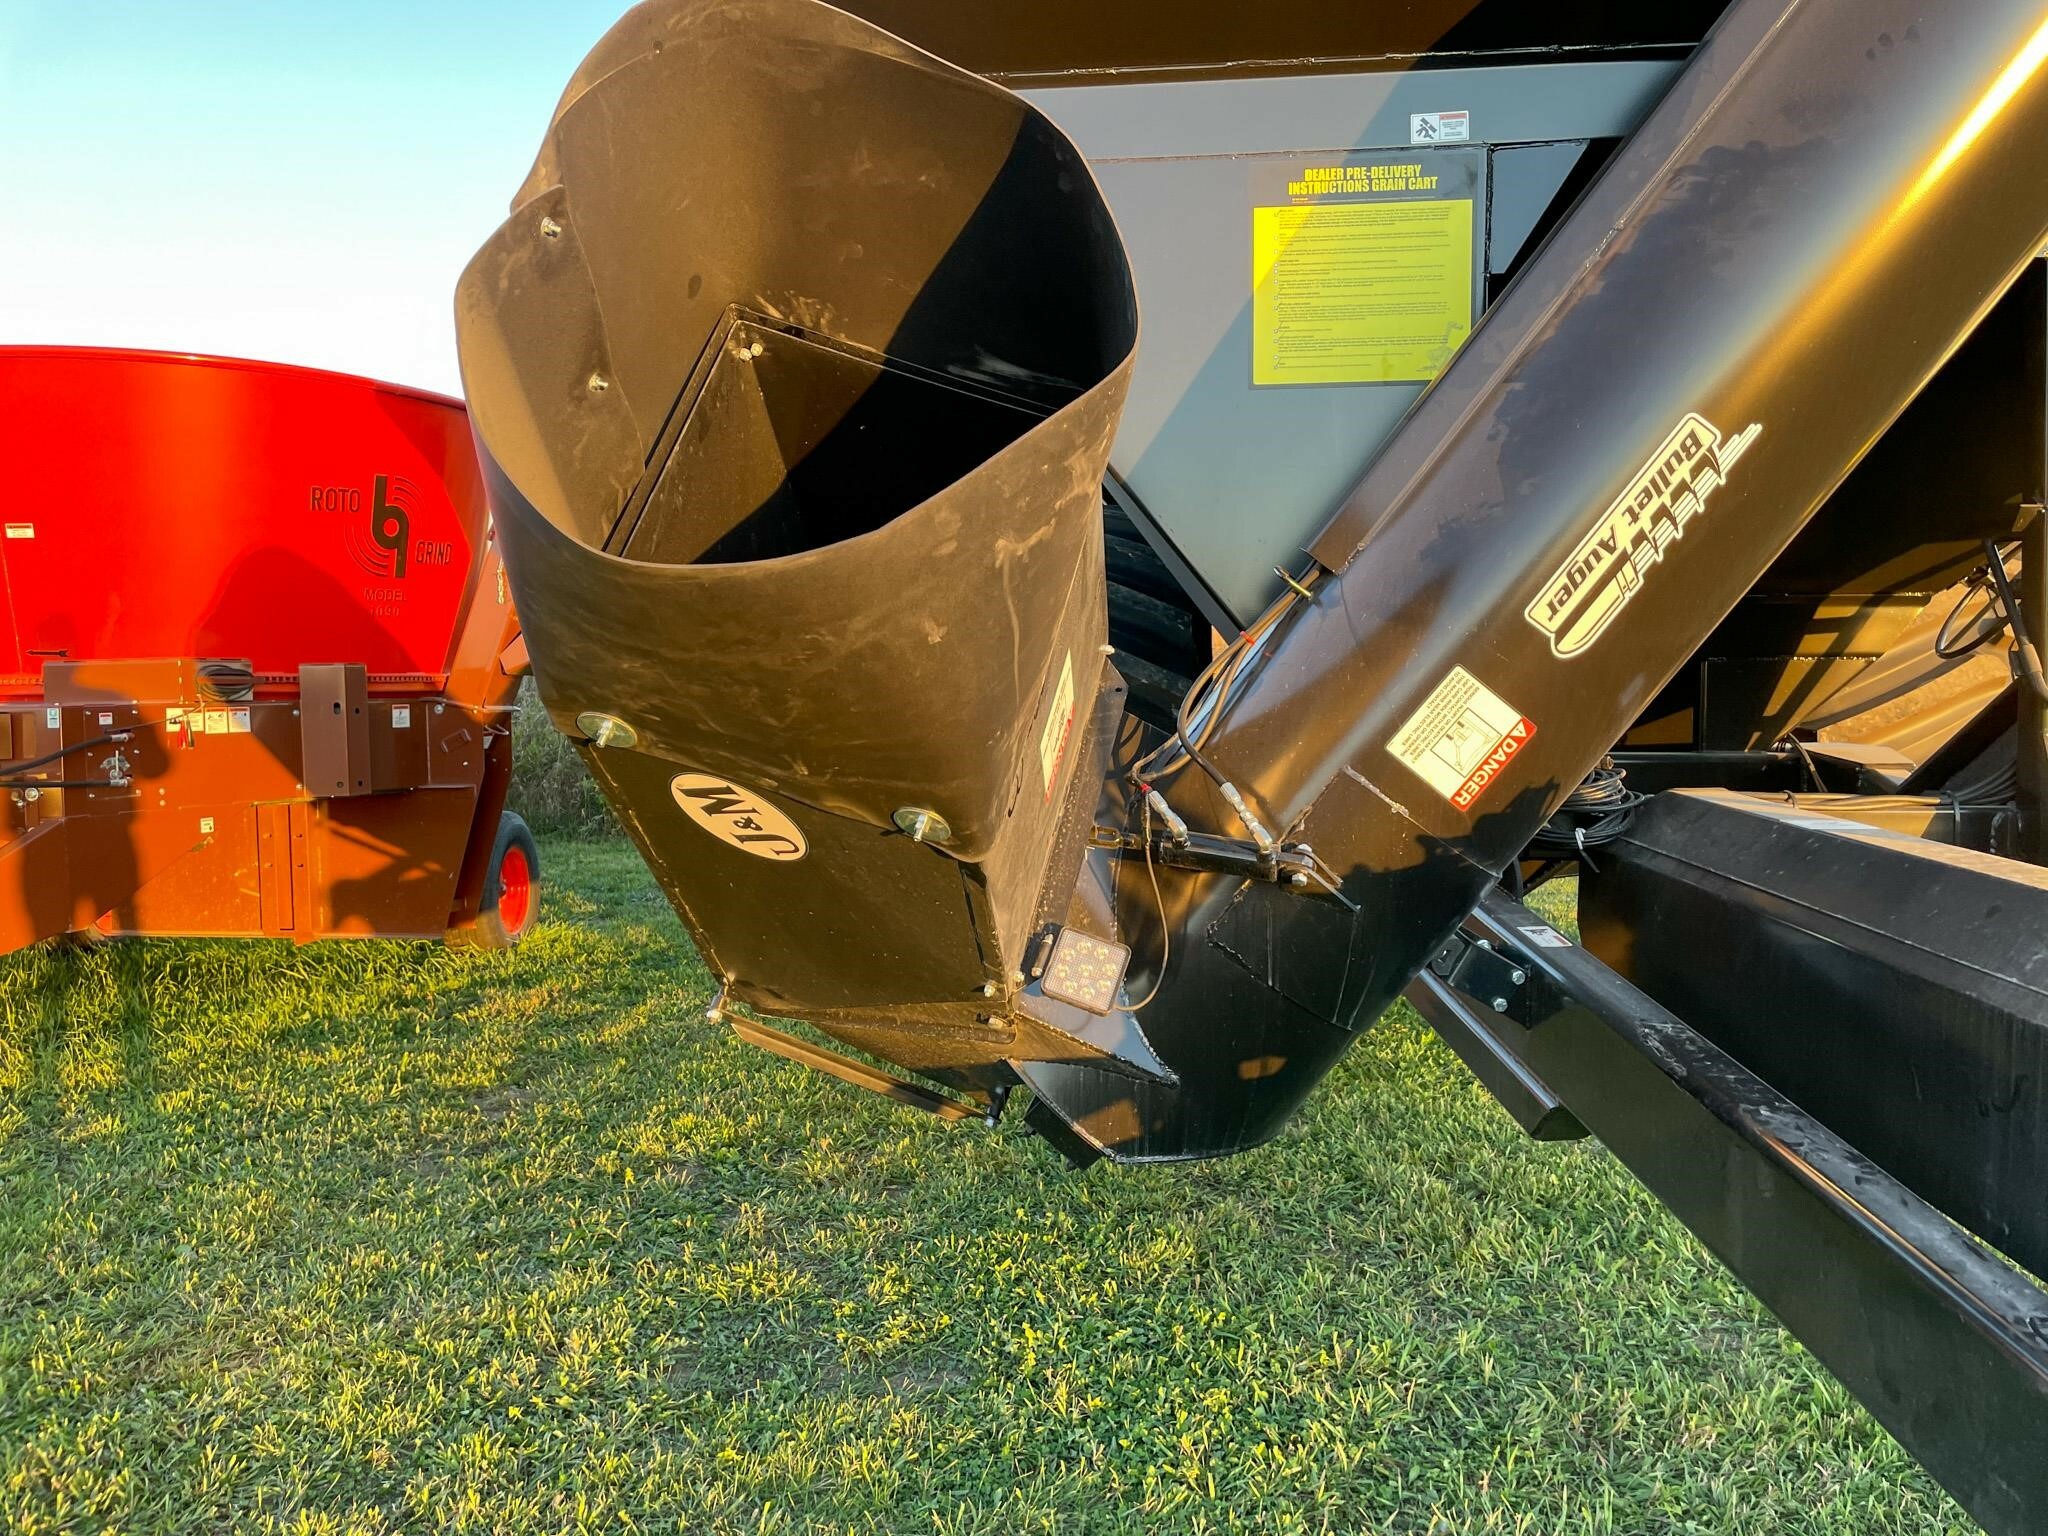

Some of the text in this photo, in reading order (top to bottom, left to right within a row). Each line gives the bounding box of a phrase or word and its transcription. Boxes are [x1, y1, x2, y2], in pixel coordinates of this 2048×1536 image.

[1288, 176, 1438, 195] INSTRUCTIONS GRAIN CART
[1304, 165, 1421, 182] DEALER PRE-DELIVERY
[310, 486, 361, 513] ROTO
[1545, 428, 1704, 622] Bullet Auger
[415, 539, 453, 566] GRIND
[364, 588, 407, 601] MODEL
[1454, 736, 1518, 807] DANGER
[676, 785, 799, 856] J&M
